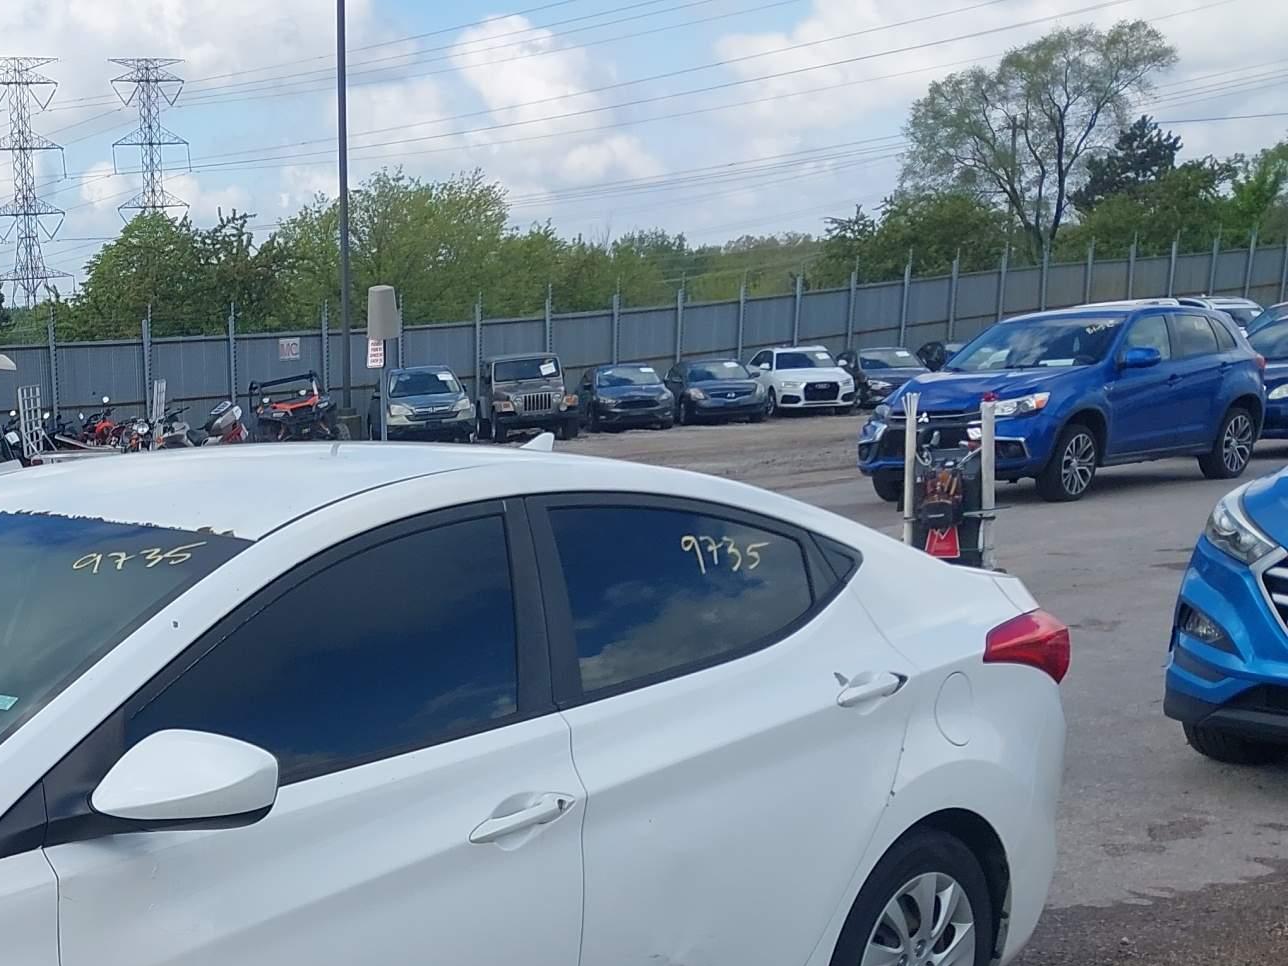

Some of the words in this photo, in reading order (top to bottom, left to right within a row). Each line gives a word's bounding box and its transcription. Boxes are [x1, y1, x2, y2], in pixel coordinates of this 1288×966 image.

[280, 342, 298, 356] MC
[73, 541, 207, 573] 9735
[681, 535, 769, 574] 9735
